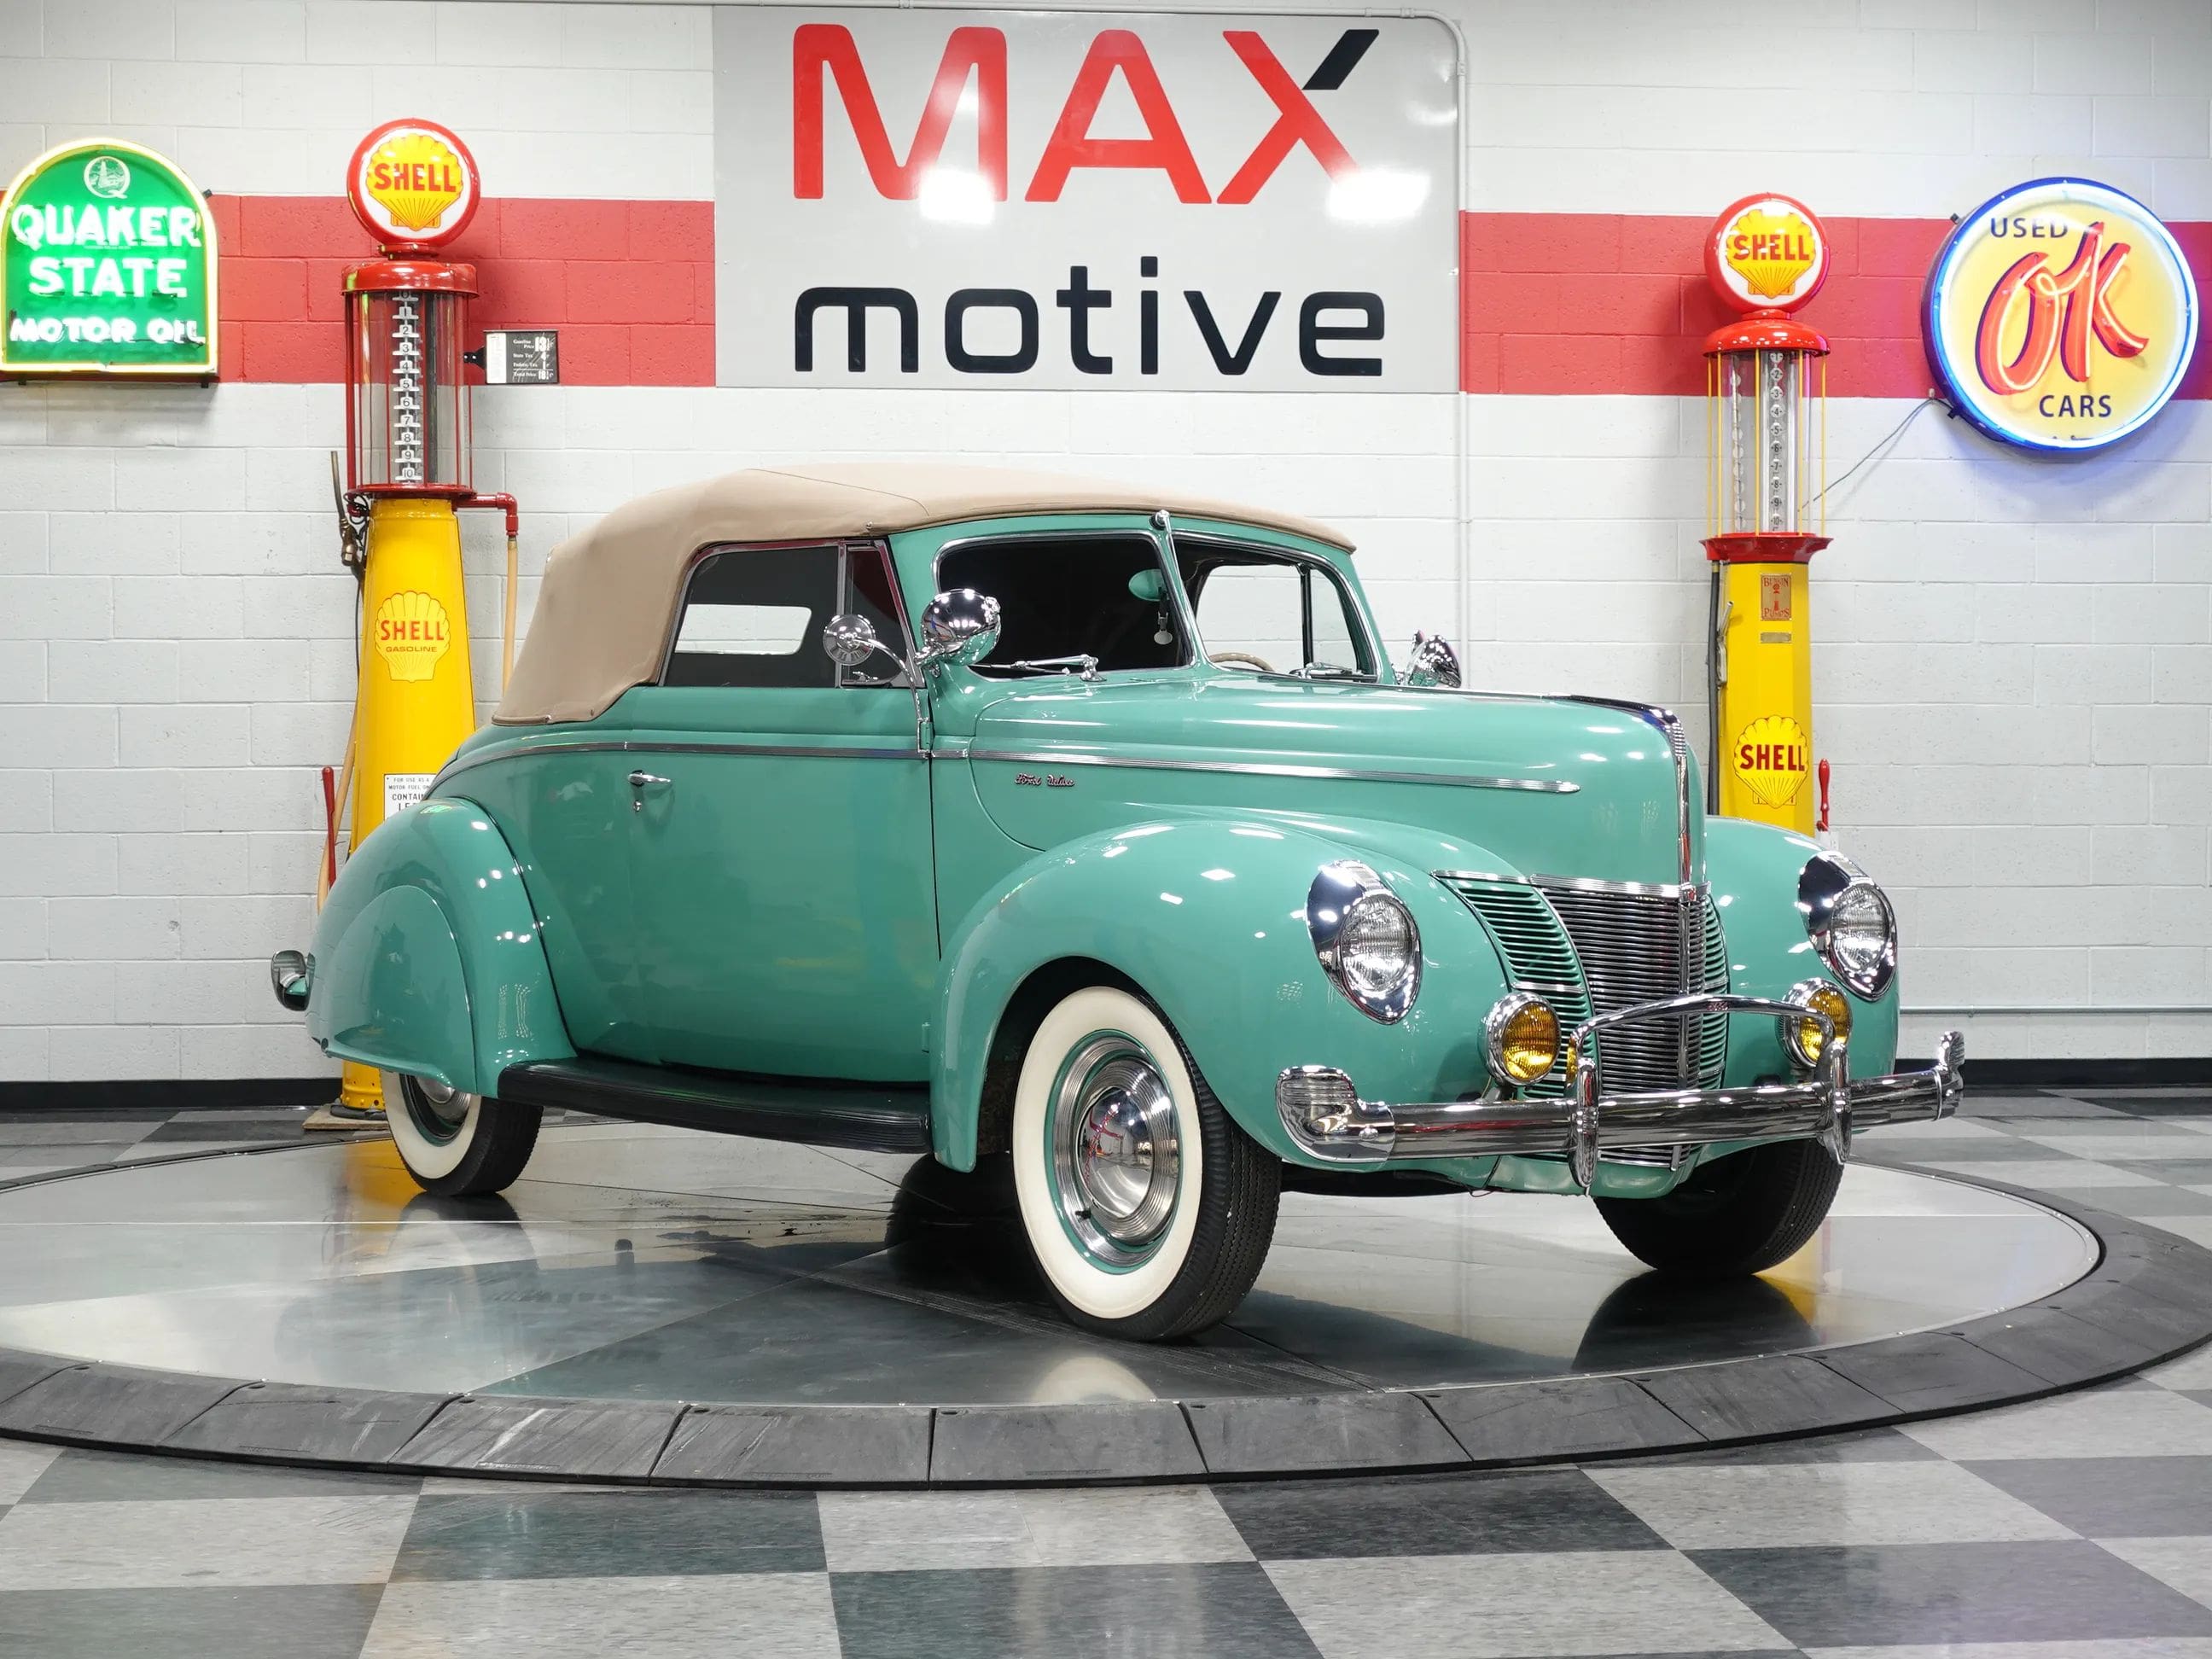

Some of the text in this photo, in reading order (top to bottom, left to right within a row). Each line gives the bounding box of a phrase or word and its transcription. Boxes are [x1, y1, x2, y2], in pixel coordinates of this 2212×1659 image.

[794, 24, 1379, 205] MAX
[374, 163, 457, 193] SHELL
[10, 204, 201, 250] QUAKER
[1990, 217, 2069, 238] USED
[1733, 234, 1810, 261] SHELL
[28, 257, 188, 298] STATE
[795, 255, 1385, 375] motive
[1975, 221, 2149, 396] OK
[10, 317, 206, 344] MOTOR OIL
[2039, 395, 2112, 417] CARS
[381, 620, 445, 641] SHELL
[1739, 744, 1805, 771] SHELL
